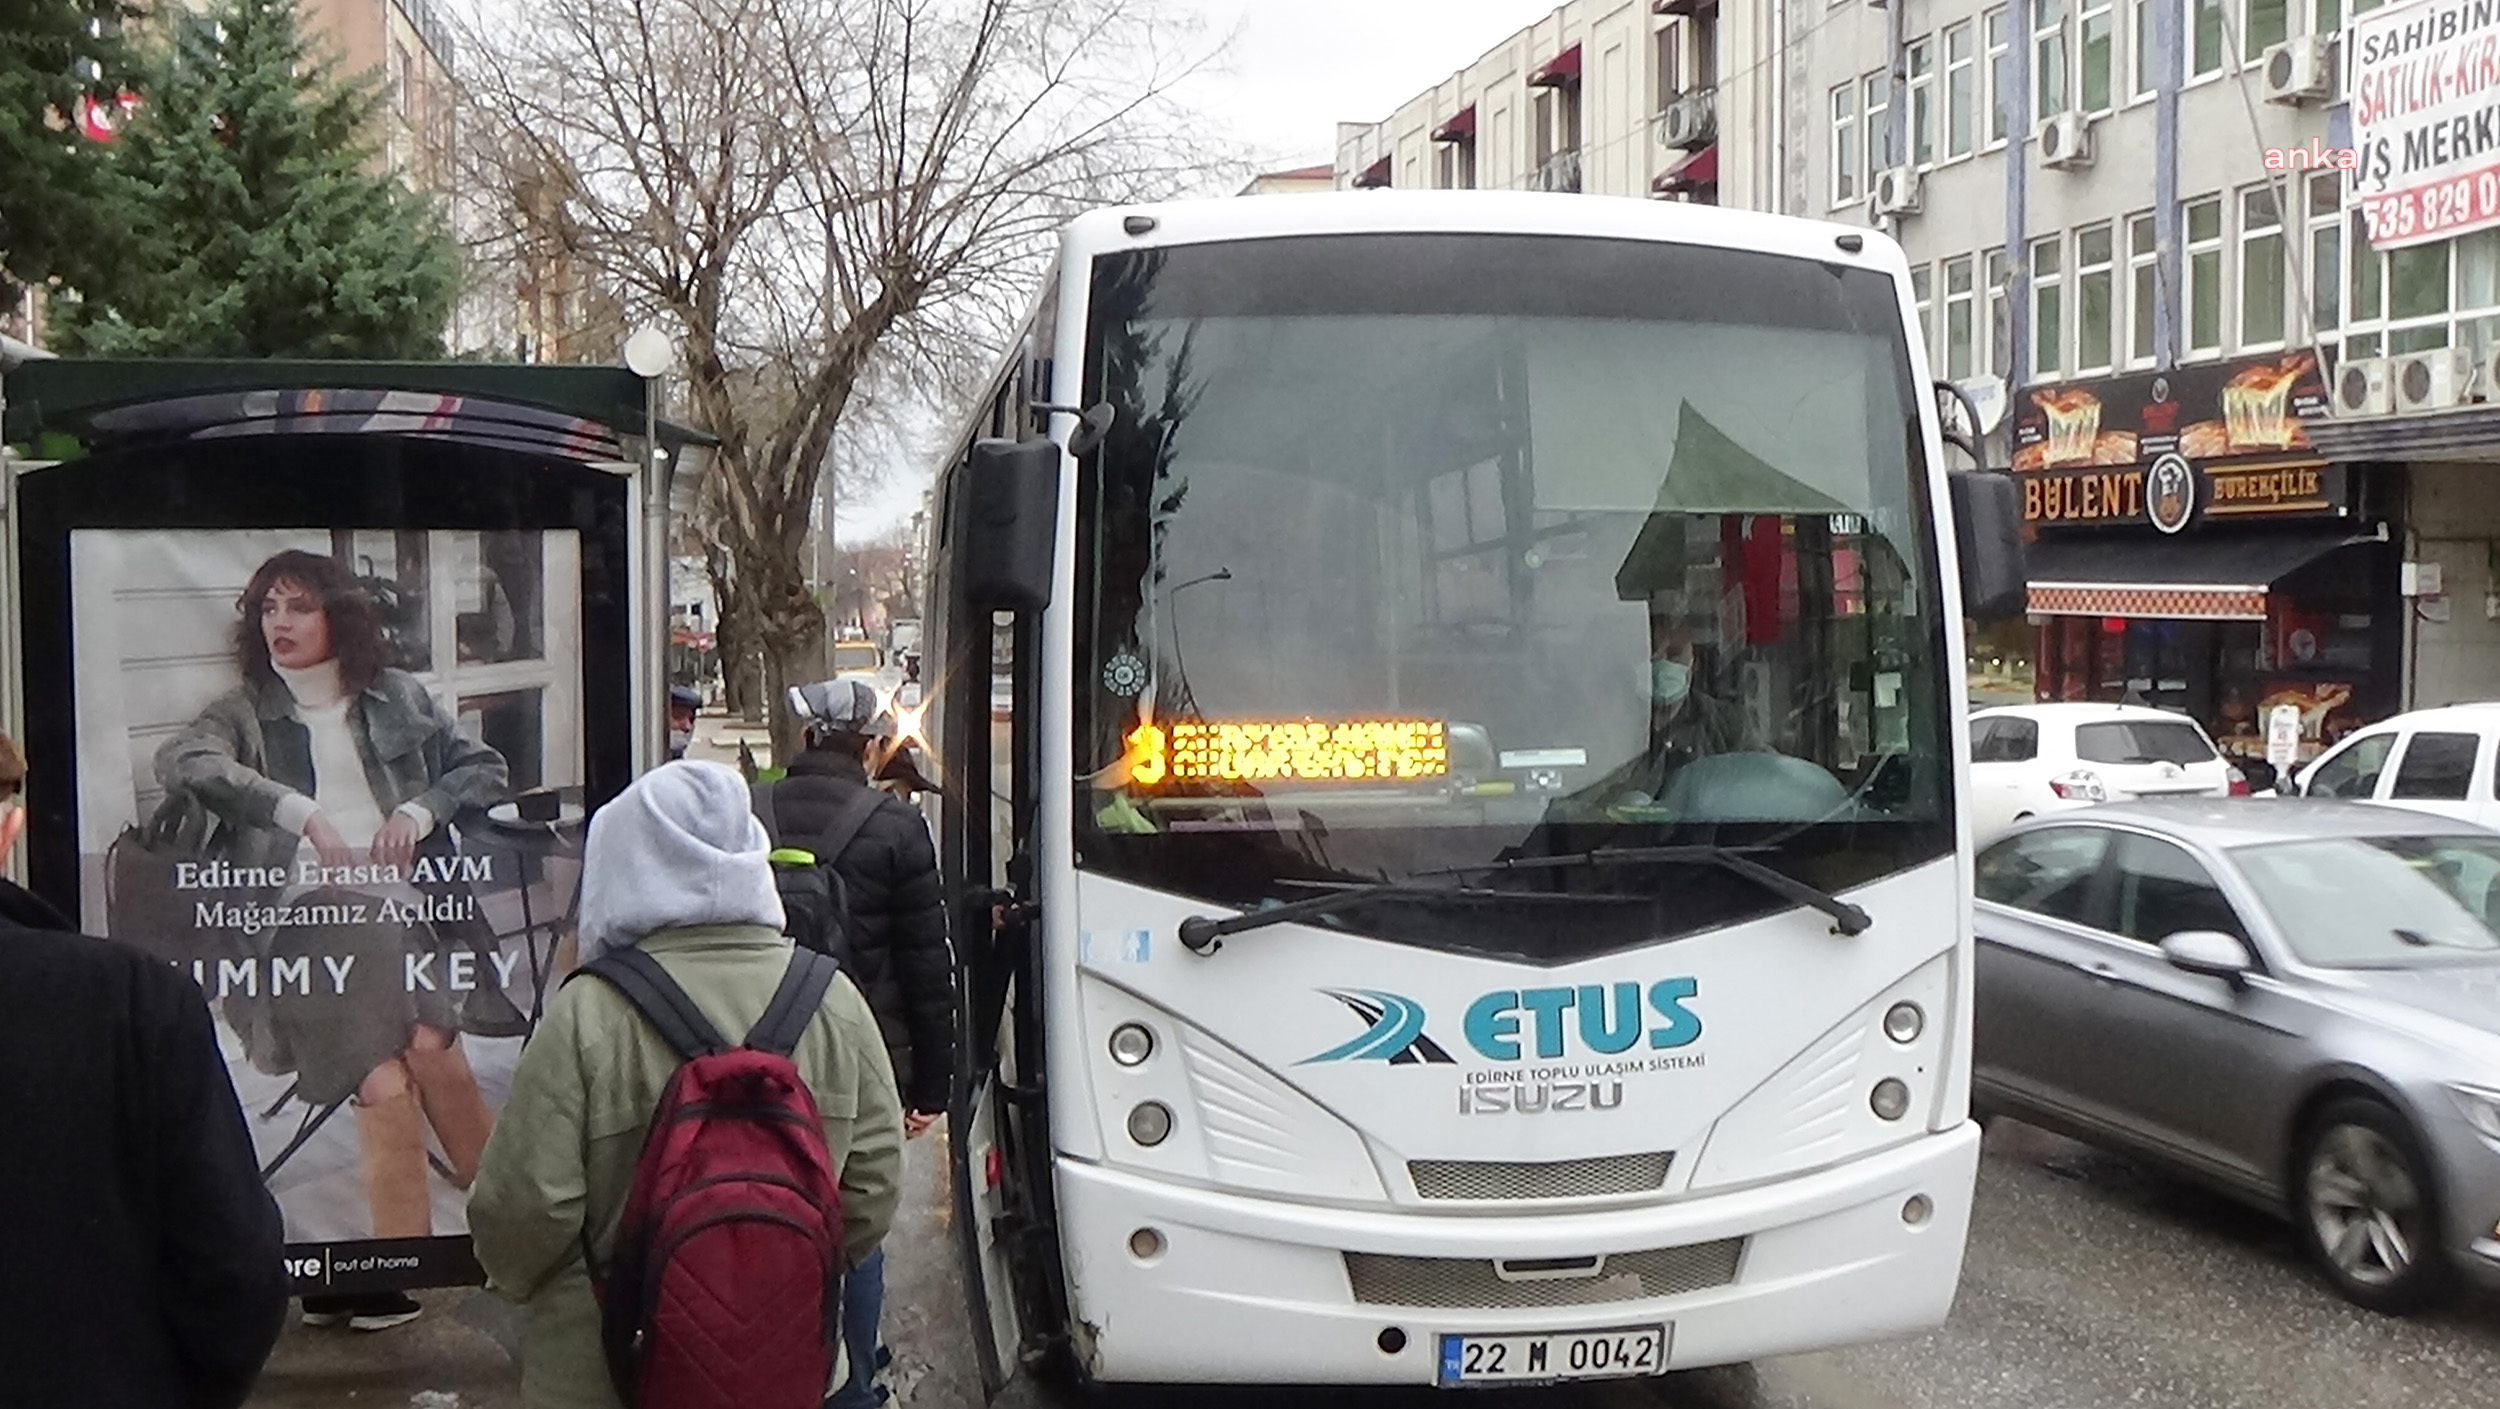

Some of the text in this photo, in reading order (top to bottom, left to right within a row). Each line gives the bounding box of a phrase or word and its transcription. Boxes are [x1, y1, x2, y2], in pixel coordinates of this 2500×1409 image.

[2362, 0, 2500, 66] SAHİBİN
[2359, 104, 2500, 193] İŞ MERK
[2422, 178, 2470, 231] 829
[2478, 171, 2500, 216] 0
[176, 855, 493, 889] Edirne Erasta AVM
[194, 896, 474, 934] Mağazamız Açıldı!
[170, 950, 520, 998] IMMY KEY
[1464, 976, 1702, 1061] ETUS
[1466, 1054, 1707, 1085] EDİRNE TOPLU ULAŞIM SİSTEMİ
[1458, 1080, 1623, 1115] ISUZU
[333, 1259, 358, 1272] out
[377, 1256, 419, 1270] home
[1465, 1343, 1507, 1374] 22
[1528, 1342, 1548, 1372] M
[1570, 1336, 1653, 1370] 0042
